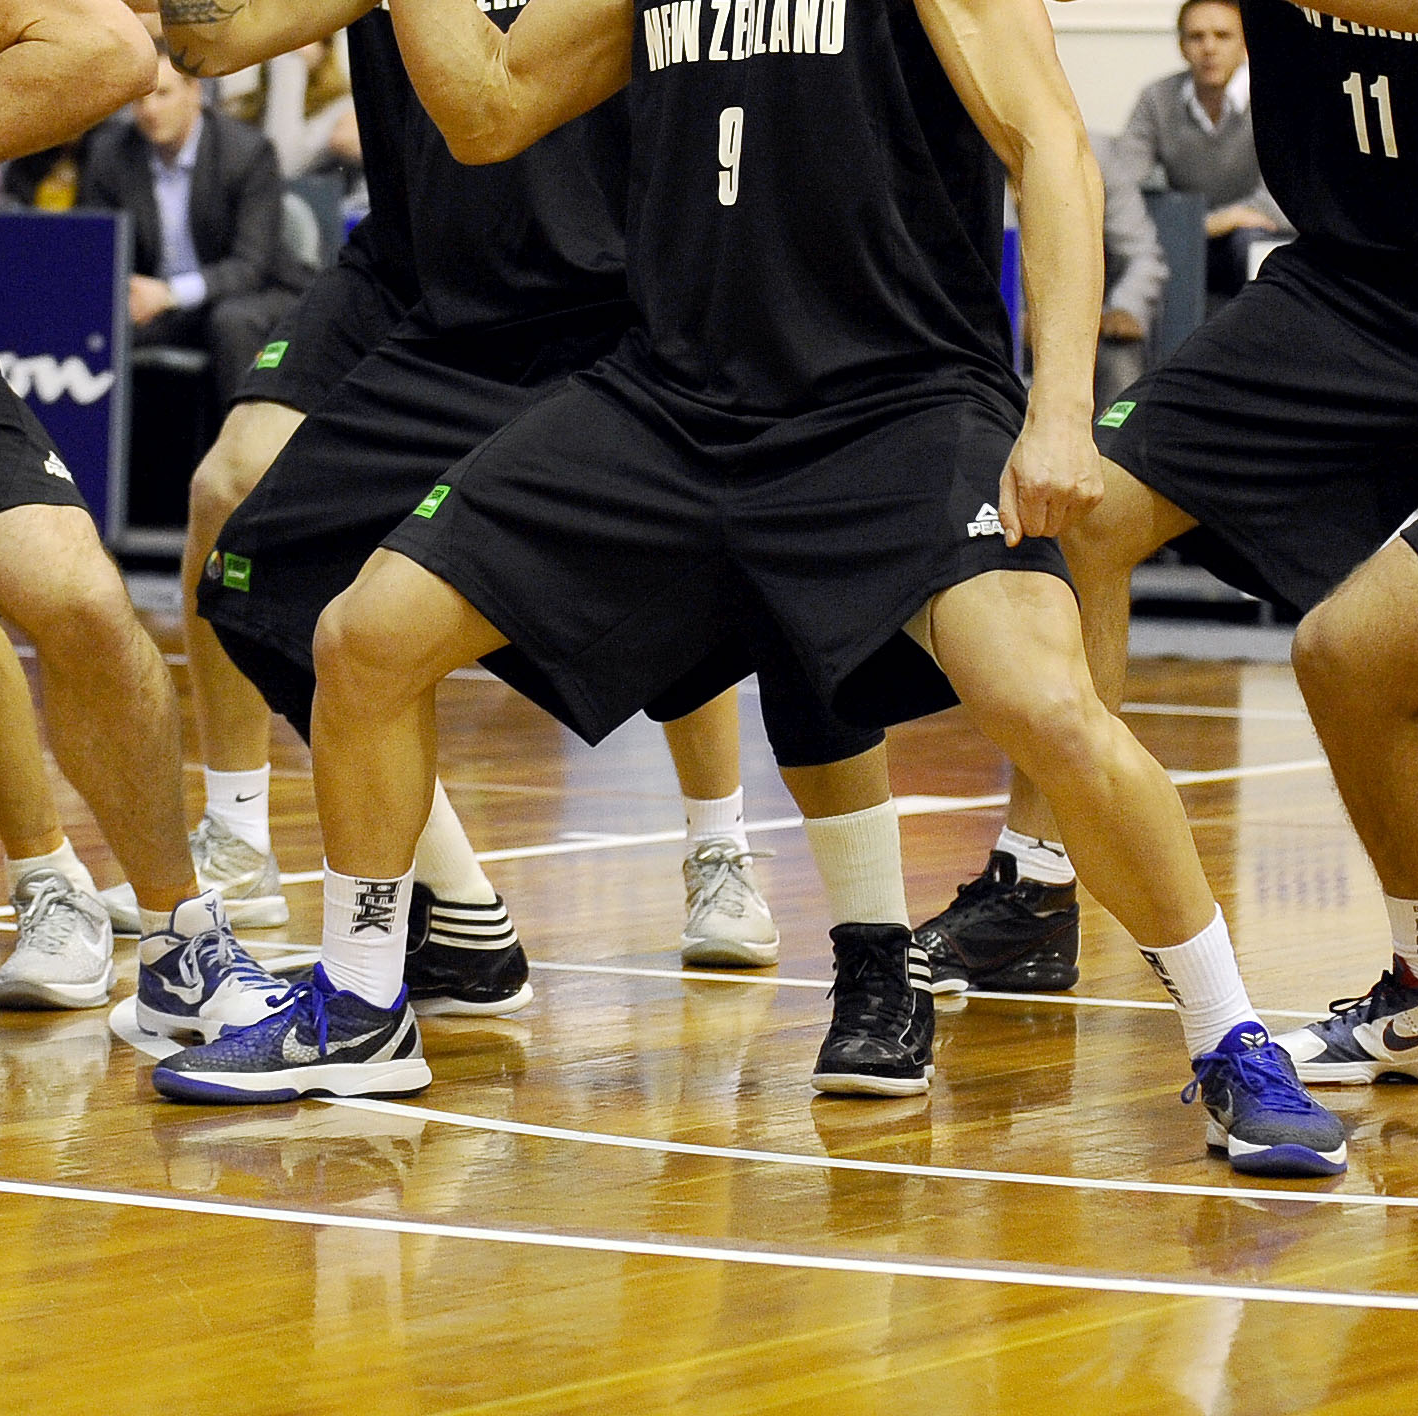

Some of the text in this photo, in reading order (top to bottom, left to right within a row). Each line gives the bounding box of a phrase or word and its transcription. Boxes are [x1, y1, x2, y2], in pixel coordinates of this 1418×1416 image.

[1343, 72, 1399, 159] 11
[718, 107, 744, 206] 9
[967, 520, 1006, 538] PEA
[350, 878, 403, 934] PEAK
